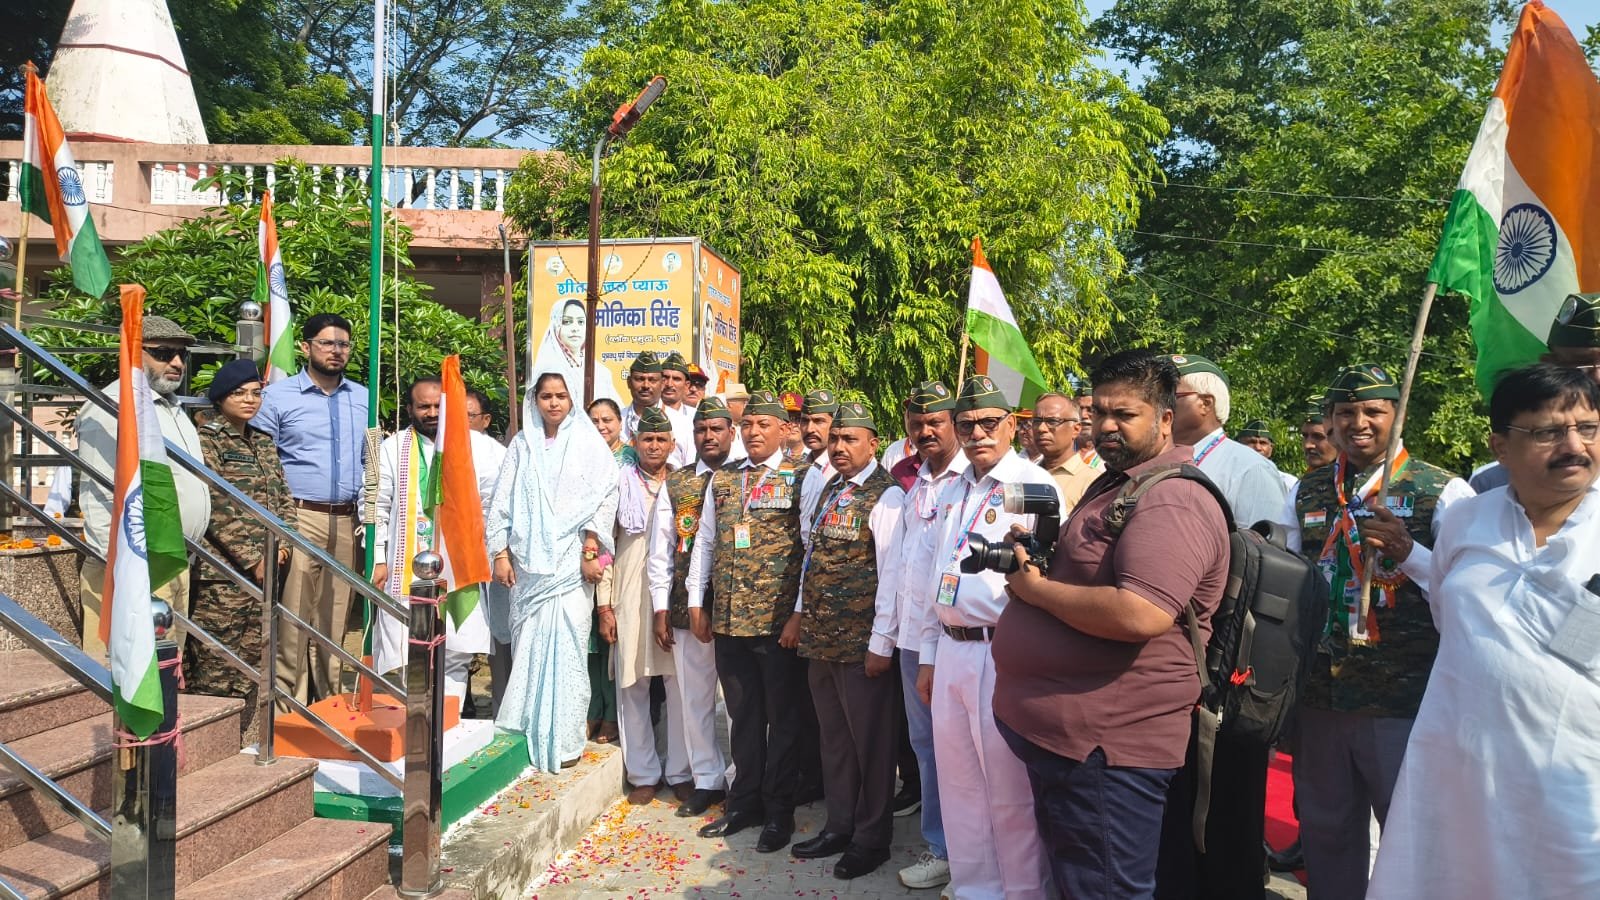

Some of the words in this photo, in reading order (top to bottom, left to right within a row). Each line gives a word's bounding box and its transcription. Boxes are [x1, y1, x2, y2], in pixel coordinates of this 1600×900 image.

[557, 279, 588, 294] शीत
[604, 280, 627, 292] जल
[632, 280, 668, 291] प्याऊ
[595, 300, 646, 328] मोनिका
[650, 299, 681, 328] सिंह
